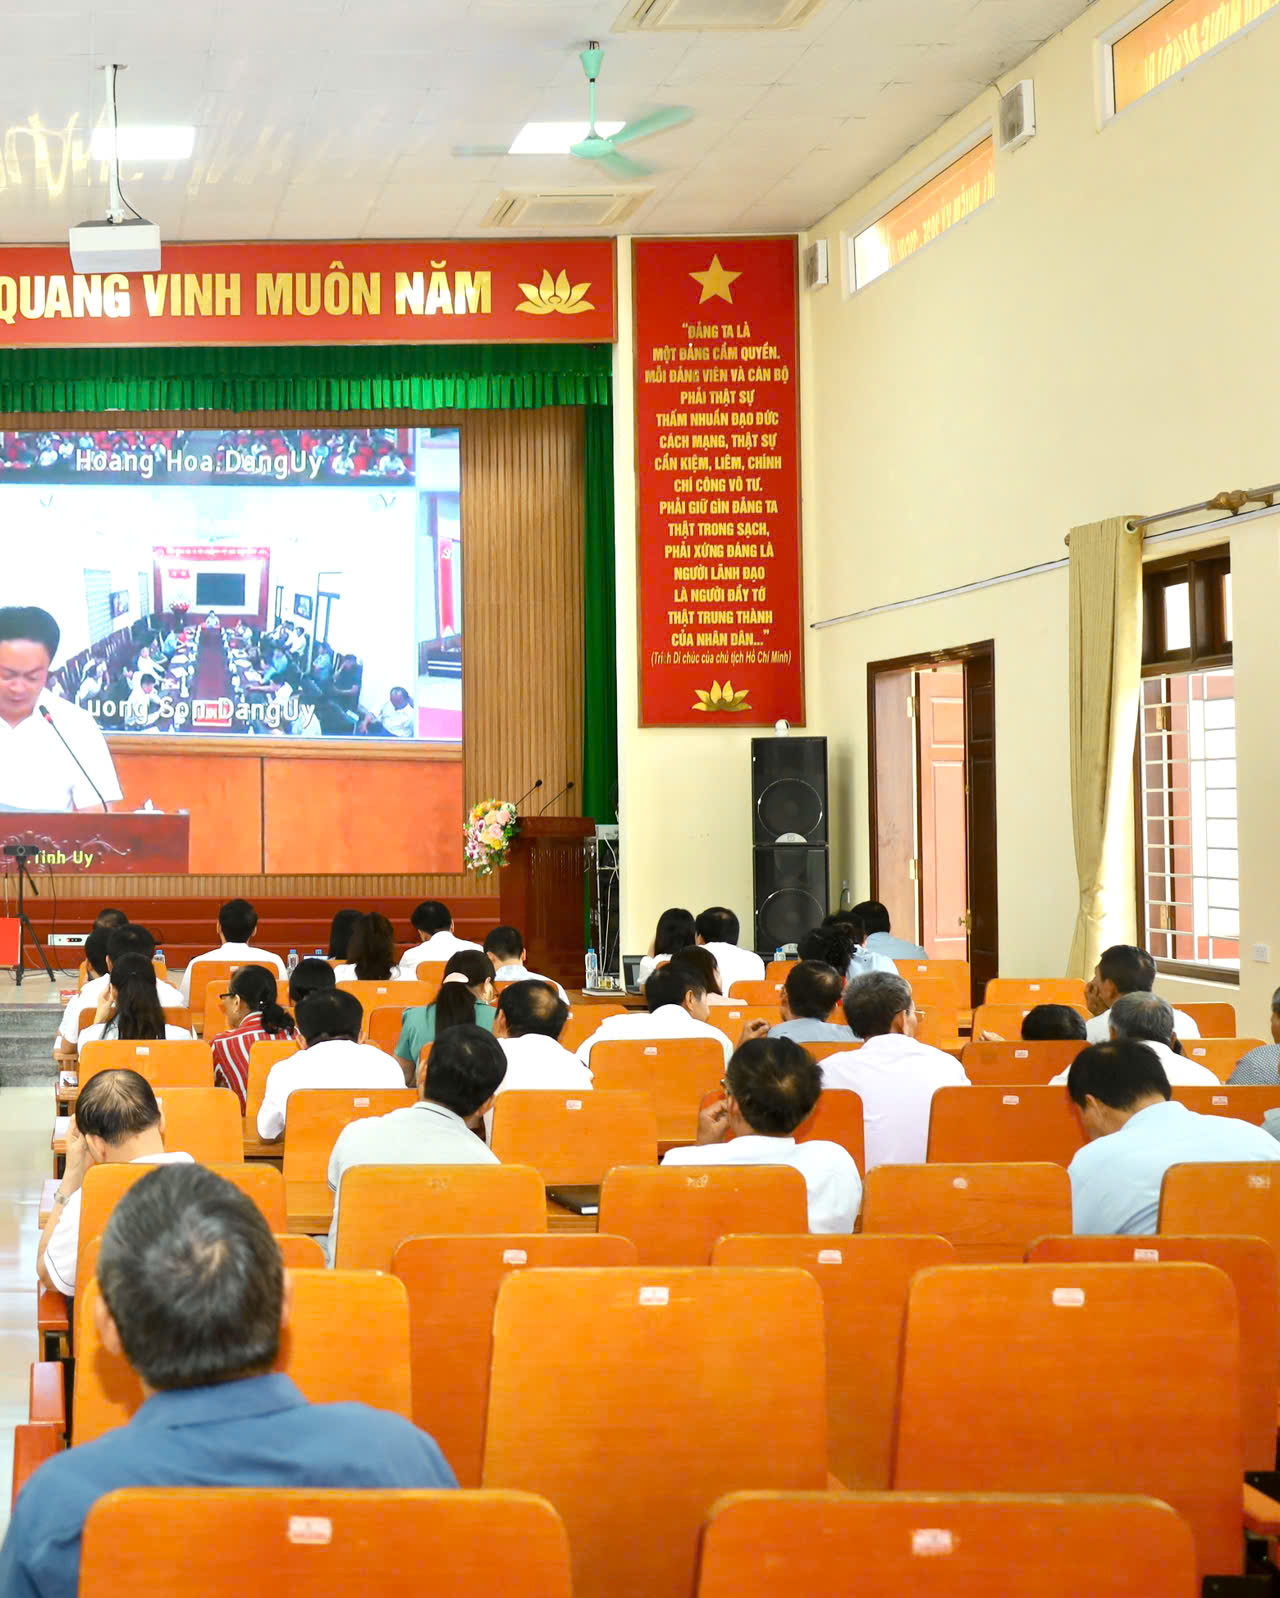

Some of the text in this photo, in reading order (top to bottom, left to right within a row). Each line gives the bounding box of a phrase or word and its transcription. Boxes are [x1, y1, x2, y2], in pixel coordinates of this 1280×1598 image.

[143, 273, 241, 317] VINH
[256, 260, 381, 316] MUÔN
[395, 260, 492, 315] NĂM
[721, 325, 734, 338] TA
[737, 321, 751, 338] LÀ
[653, 345, 676, 364] MỘT
[679, 342, 710, 360] ĐẢNG
[703, 366, 728, 382] VIÊN
[731, 366, 745, 382] VÀ
[748, 366, 771, 381] CÁN
[774, 365, 789, 384] BỘ
[680, 387, 755, 407] PHẢI THẬT SỰ
[731, 412, 754, 428] ĐẠO
[756, 409, 779, 425] ĐỨC
[659, 432, 777, 451] CÁCH MẠNG, THẬT SỰ
[76, 449, 154, 478] Hoang
[680, 454, 712, 473] KIỆM,
[715, 454, 745, 471] LIÊM,
[748, 454, 782, 469] CHÍNH
[674, 476, 763, 492] CHÍ CÔNG VÔ TƯ.
[659, 496, 778, 514] PHẢI GIỮ GÌN ĐẢNG TA
[668, 520, 769, 539] THẬT TRONG SẠCH,
[665, 541, 690, 558] PHẢI
[694, 542, 724, 558] XỨNG
[760, 541, 774, 557] LÀ
[674, 564, 765, 582] NGƯỜI LÃNH ĐẠO
[674, 586, 688, 602] LÀ
[691, 585, 724, 602] NGƯỜI
[668, 608, 773, 627] THẬT TRUNG THÀNH
[671, 629, 693, 646] CỦA
[697, 630, 727, 646] NHÂN
[651, 651, 671, 667] (Tríh
[682, 651, 700, 664] chúc
[701, 651, 714, 664] của
[716, 650, 729, 664] chủ
[757, 650, 770, 663] Chí
[771, 650, 792, 666] Minh)
[73, 850, 94, 868] Uy
